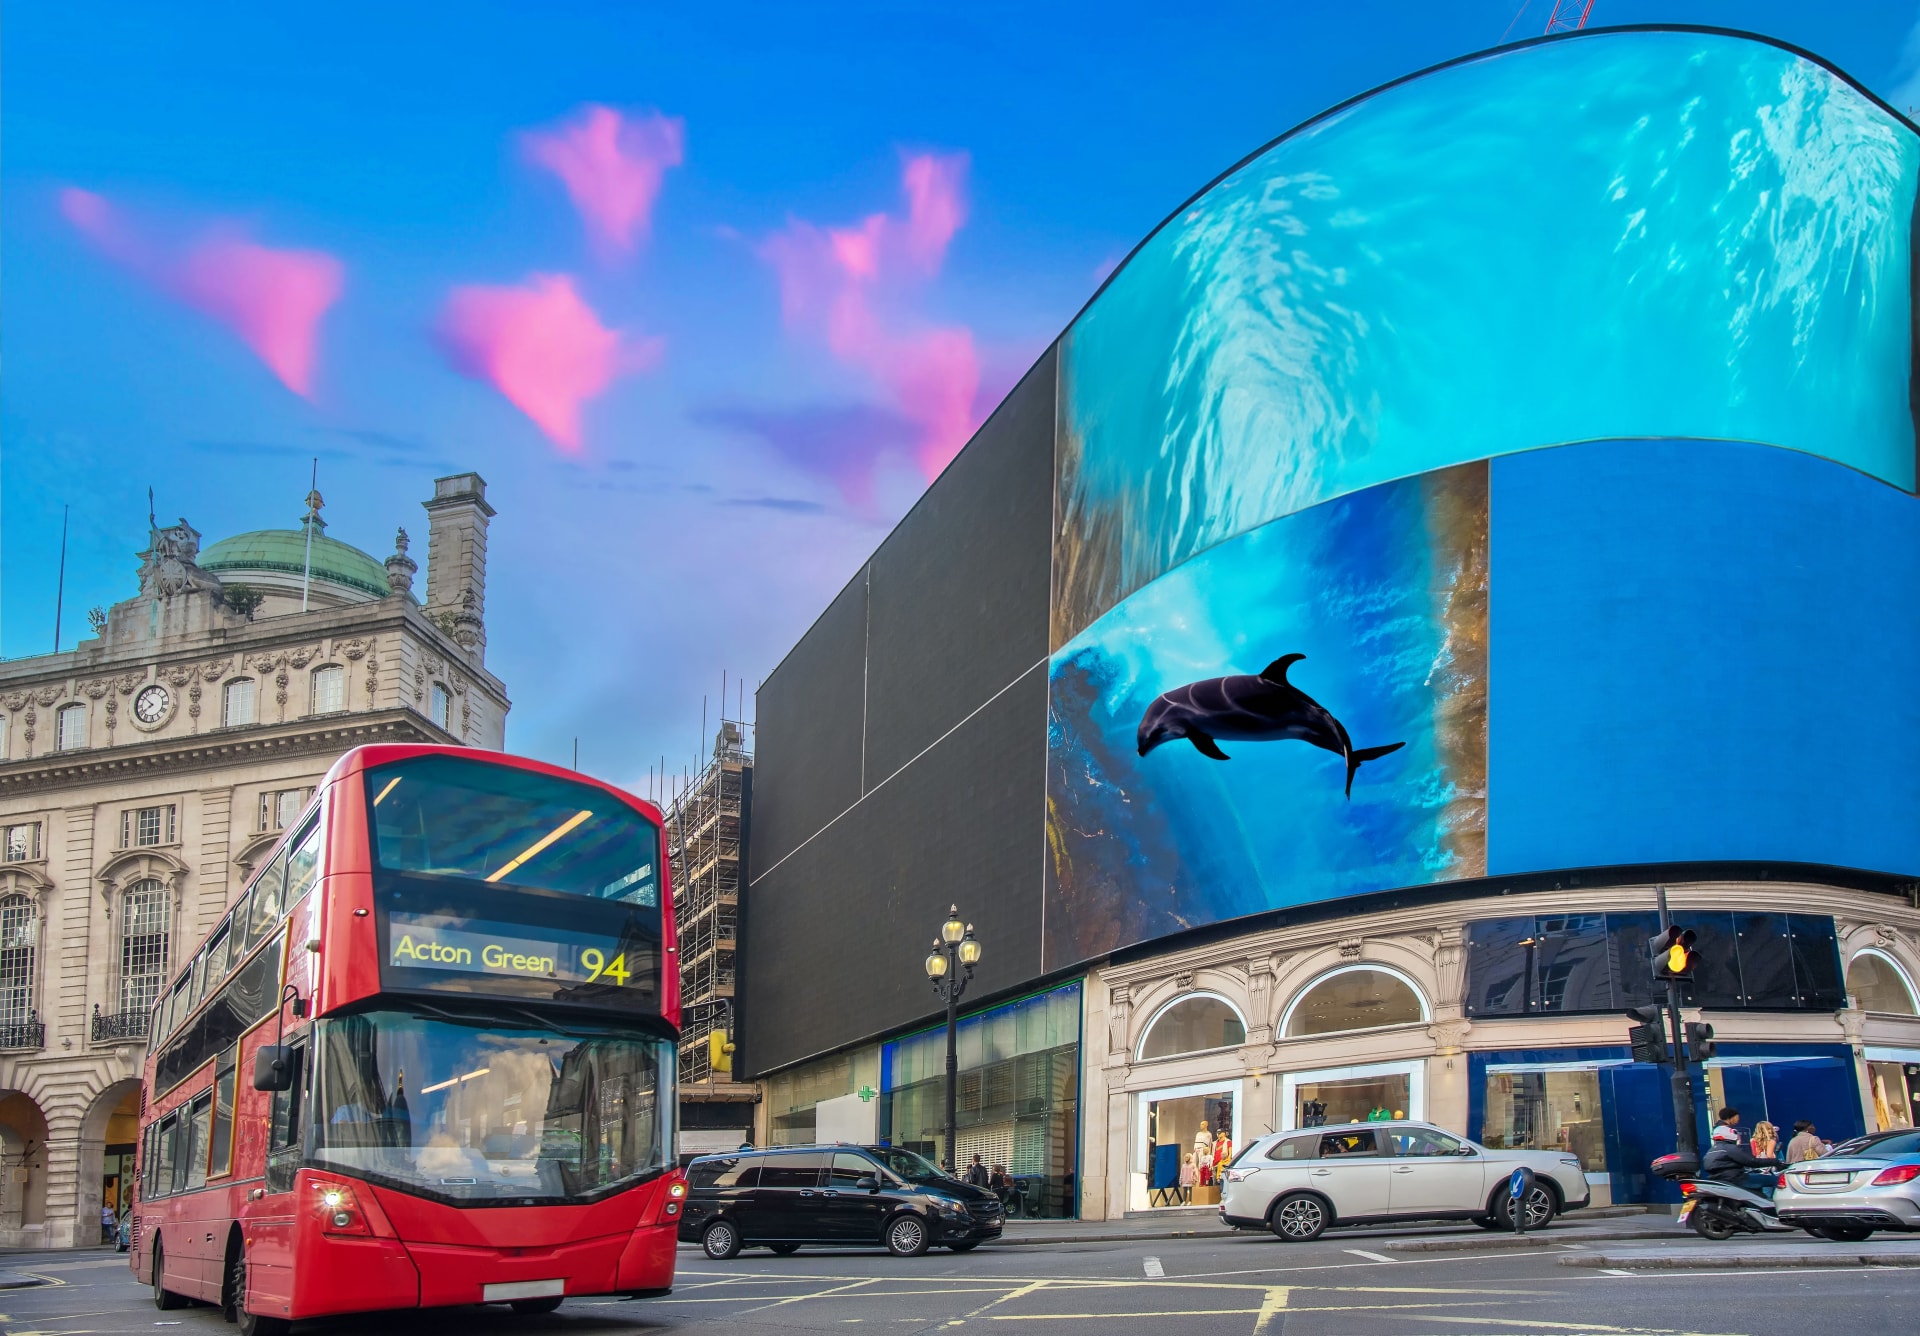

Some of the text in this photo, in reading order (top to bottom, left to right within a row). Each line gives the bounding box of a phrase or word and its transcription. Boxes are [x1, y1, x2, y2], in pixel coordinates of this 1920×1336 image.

[395, 935, 631, 986] Acton Green 94
